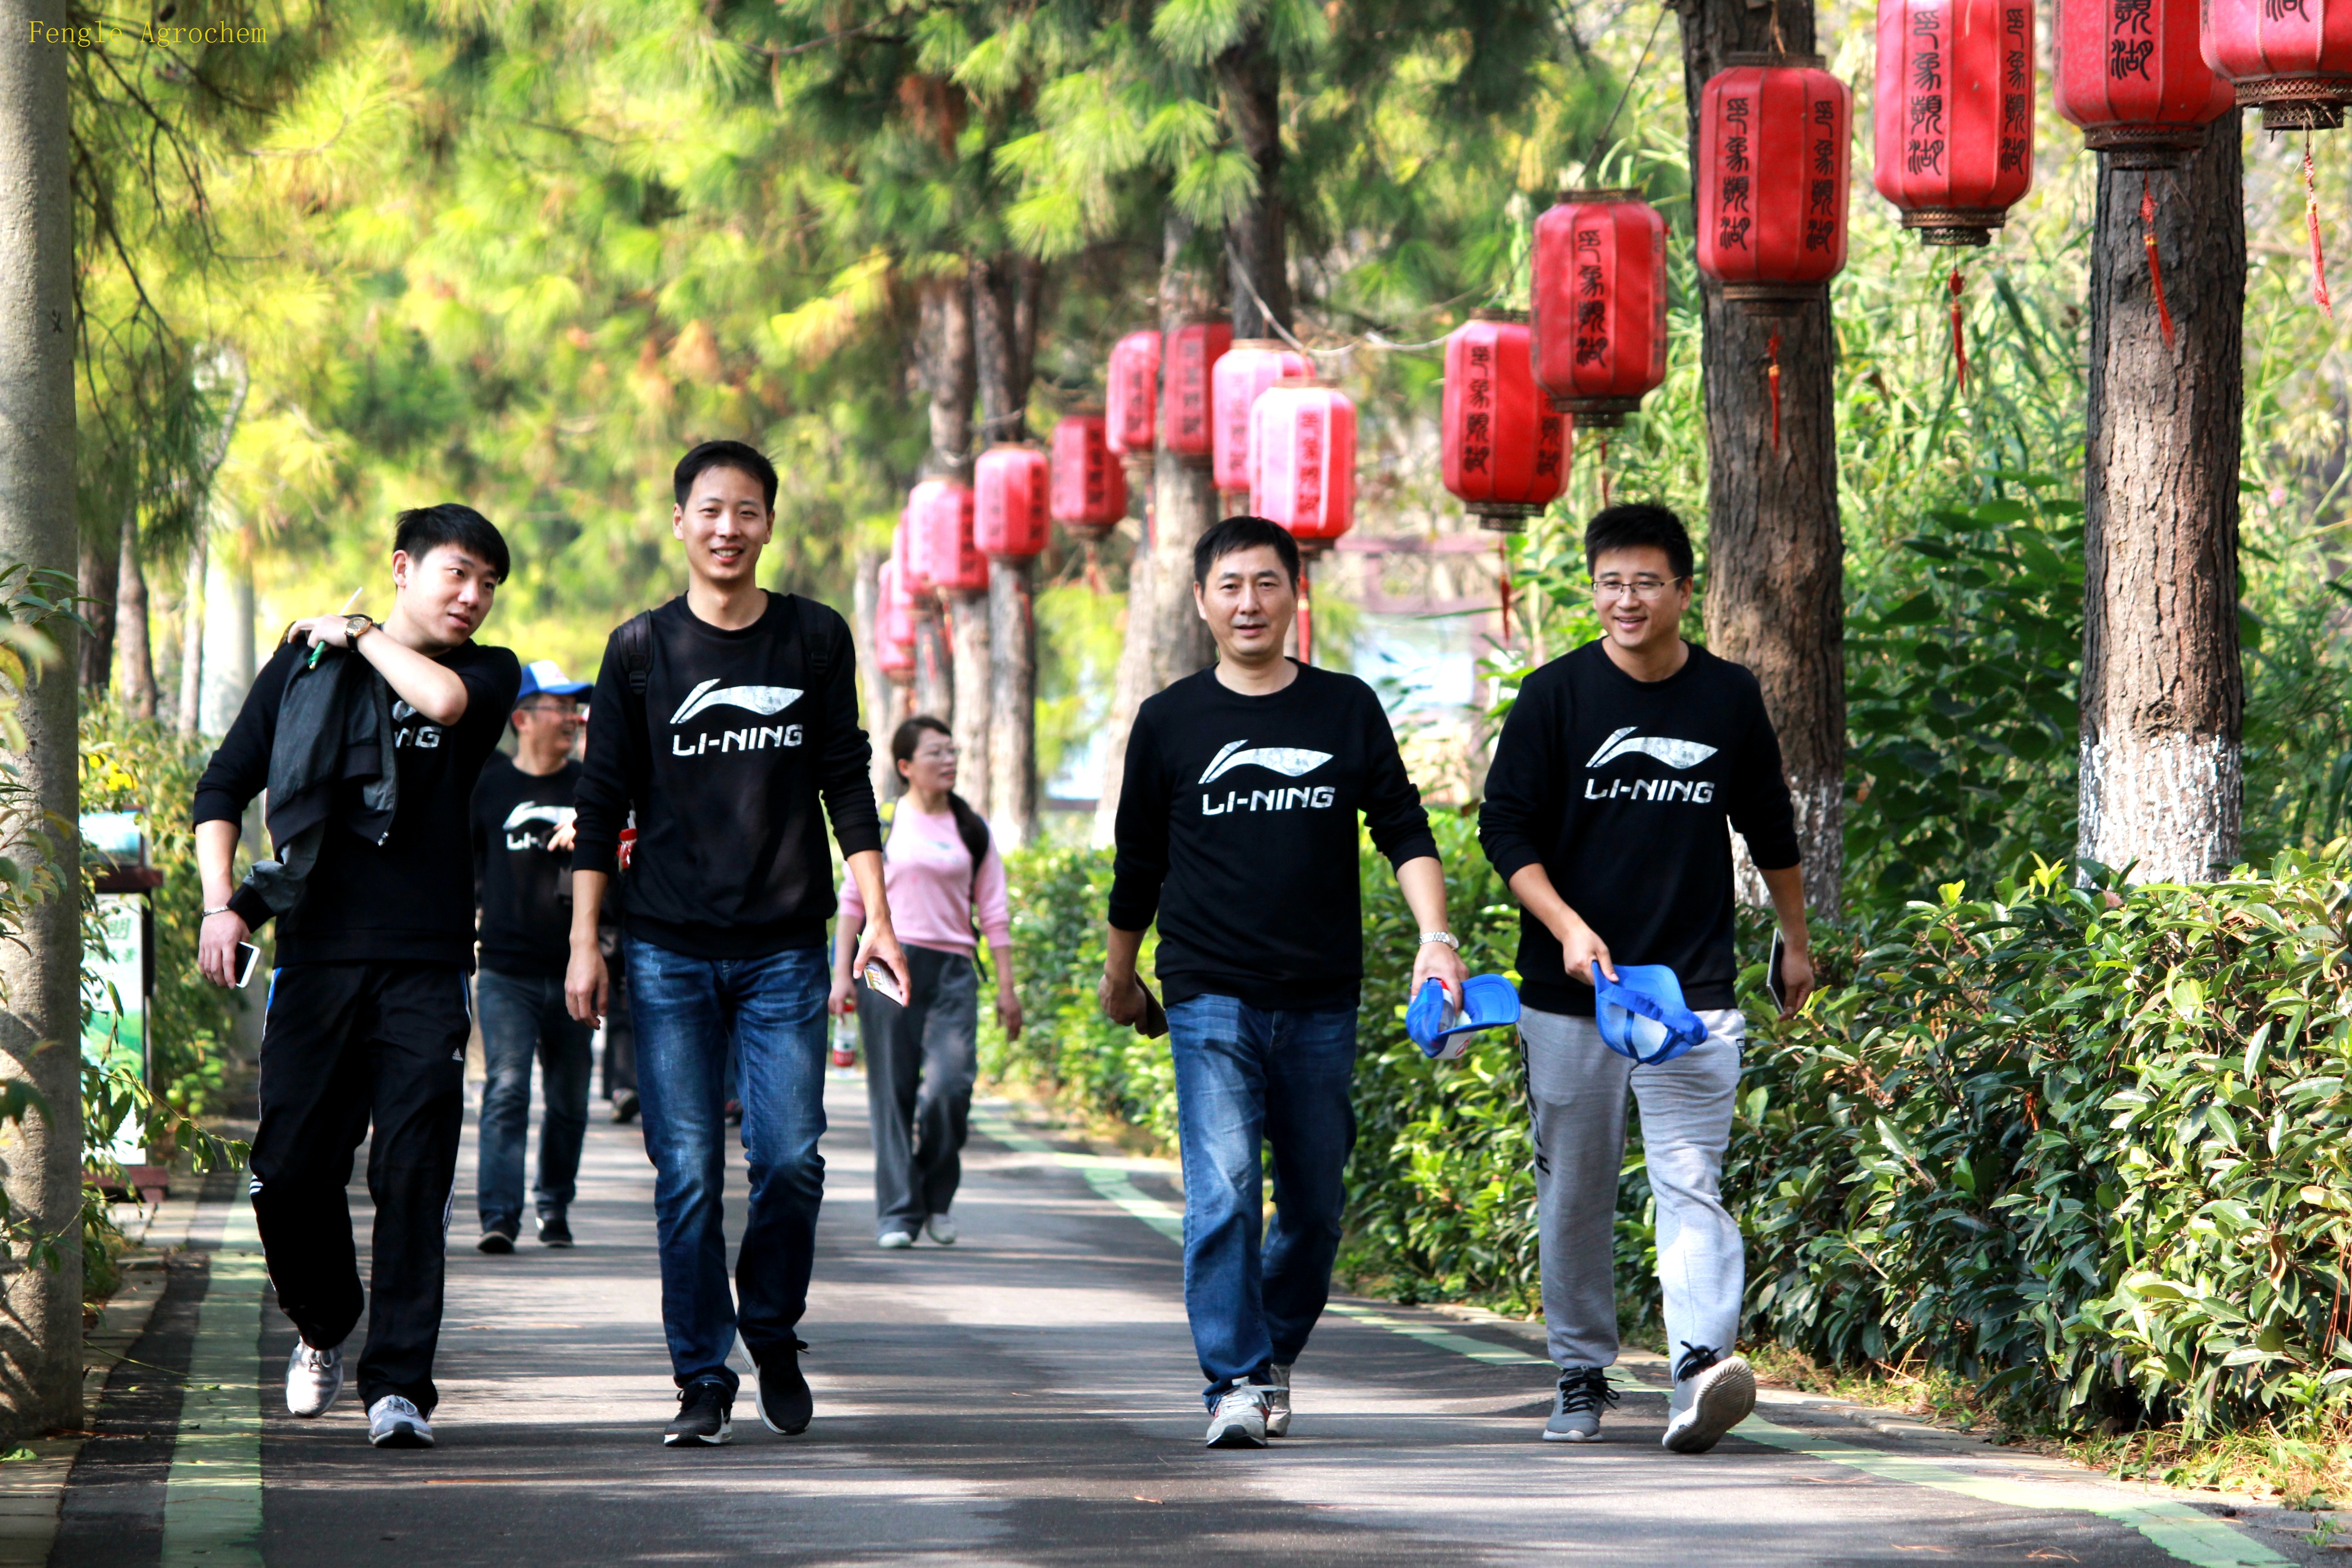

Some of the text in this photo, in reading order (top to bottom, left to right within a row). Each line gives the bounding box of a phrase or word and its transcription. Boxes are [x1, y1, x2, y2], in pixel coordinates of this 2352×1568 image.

[672, 724, 804, 757] LI-NING
[1202, 786, 1336, 816] LI-NING
[1584, 778, 1715, 804] LI-NING
